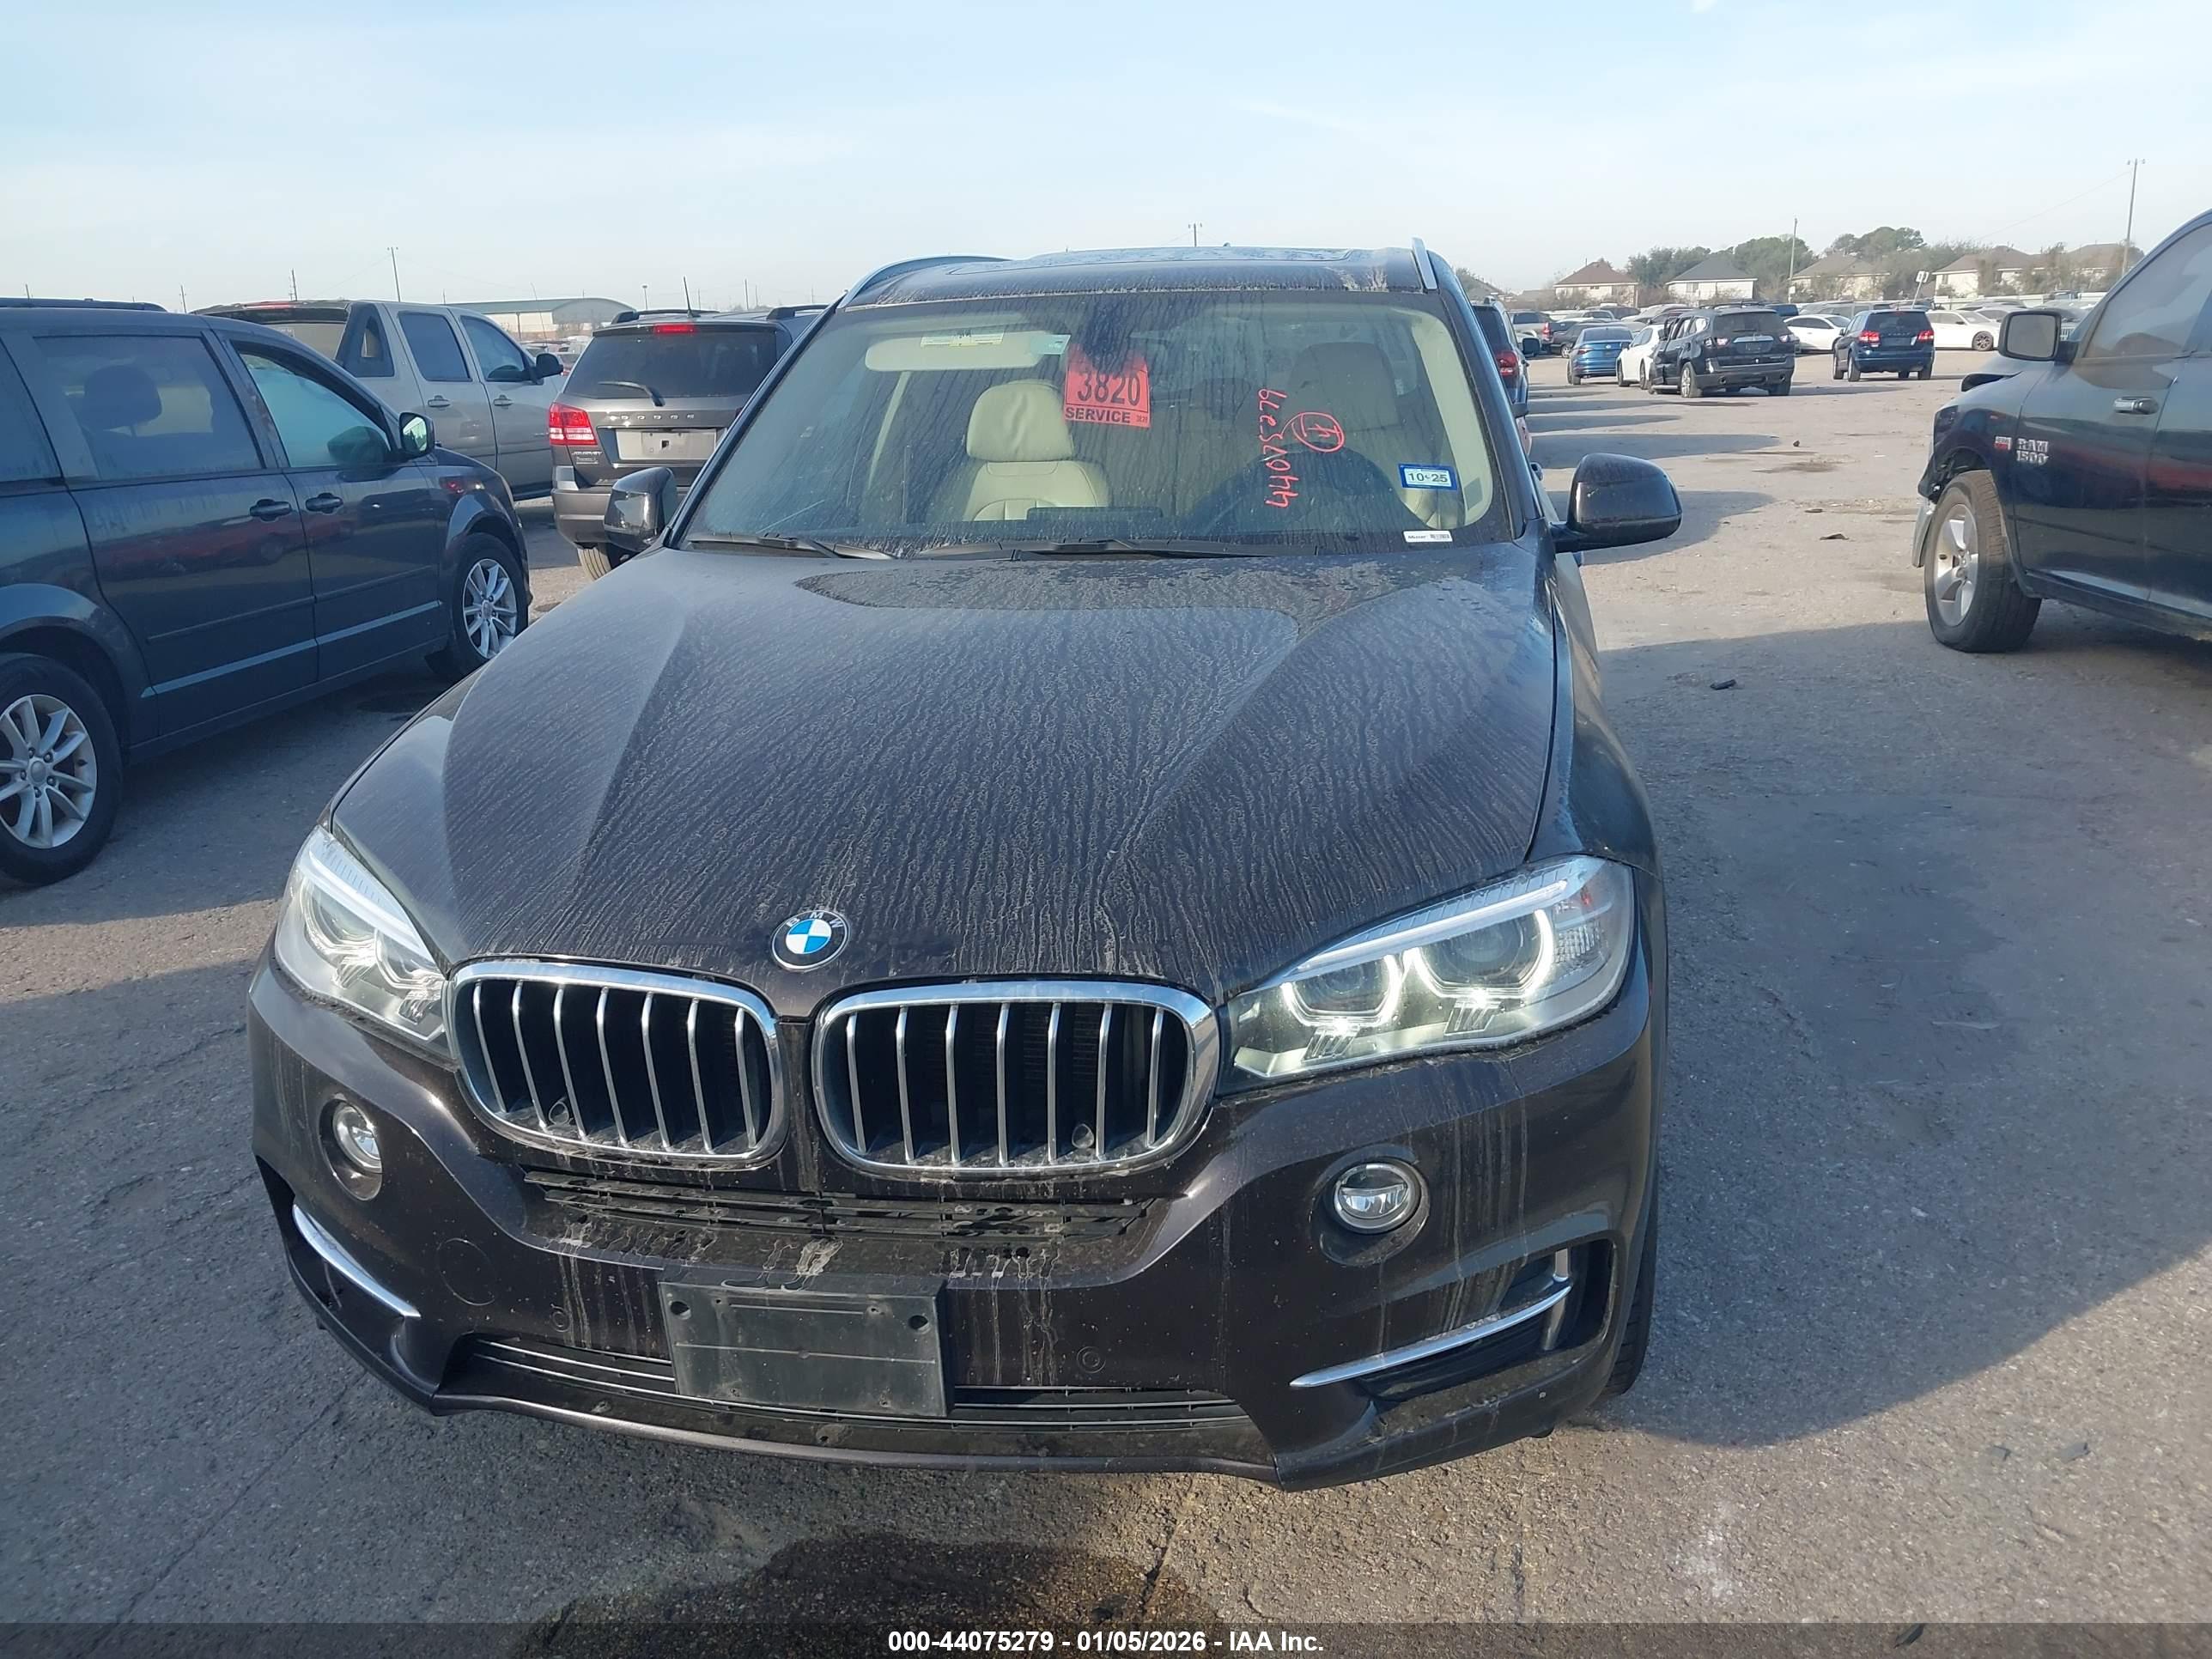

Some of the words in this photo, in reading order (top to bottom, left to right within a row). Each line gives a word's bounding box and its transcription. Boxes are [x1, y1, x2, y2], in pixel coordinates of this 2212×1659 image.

[1077, 368, 1140, 407] 3820
[1065, 407, 1131, 424] SERVICE
[2017, 438, 2049, 453] RAM
[2016, 450, 2049, 465] 1500
[787, 912, 843, 928] BMW
